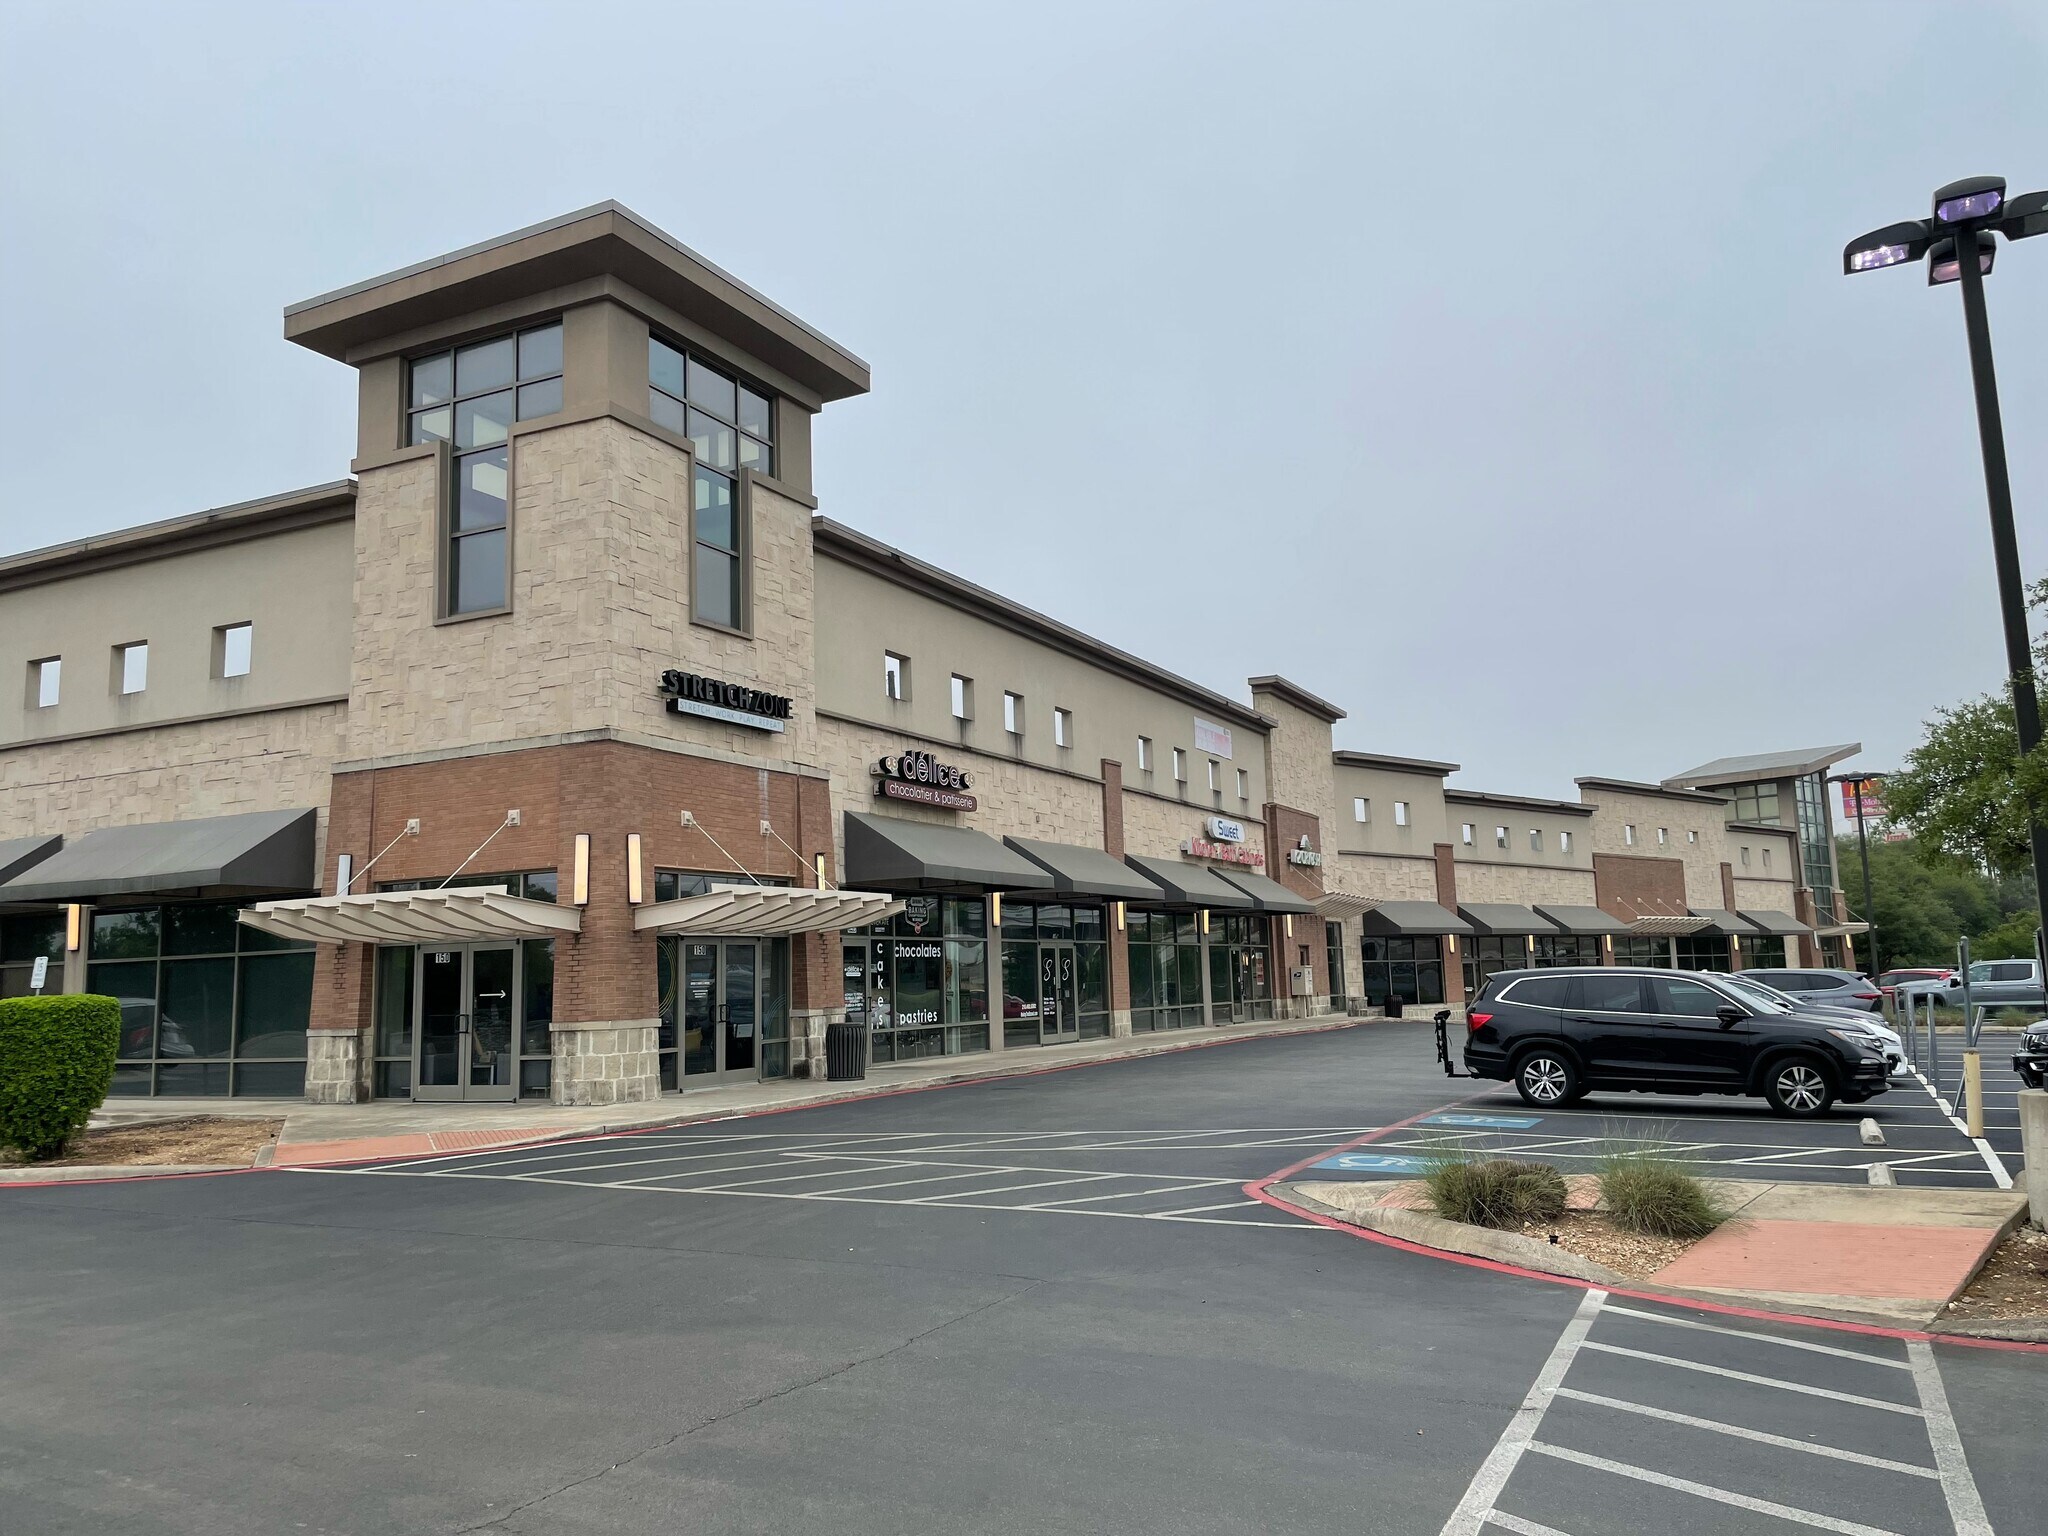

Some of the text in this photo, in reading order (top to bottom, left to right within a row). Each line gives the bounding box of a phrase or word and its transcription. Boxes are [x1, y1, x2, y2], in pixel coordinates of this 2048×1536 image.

[665, 669, 794, 720] STRETCH ZONE
[679, 702, 711, 714] STRETCH
[714, 708, 735, 720] WORK
[902, 750, 961, 789] délice
[889, 782, 933, 801] chocolatier
[934, 791, 940, 803] &
[1217, 820, 1240, 840] Sweet
[435, 952, 451, 964] 150
[894, 943, 942, 958] chocolates
[899, 1008, 939, 1025] pastries
